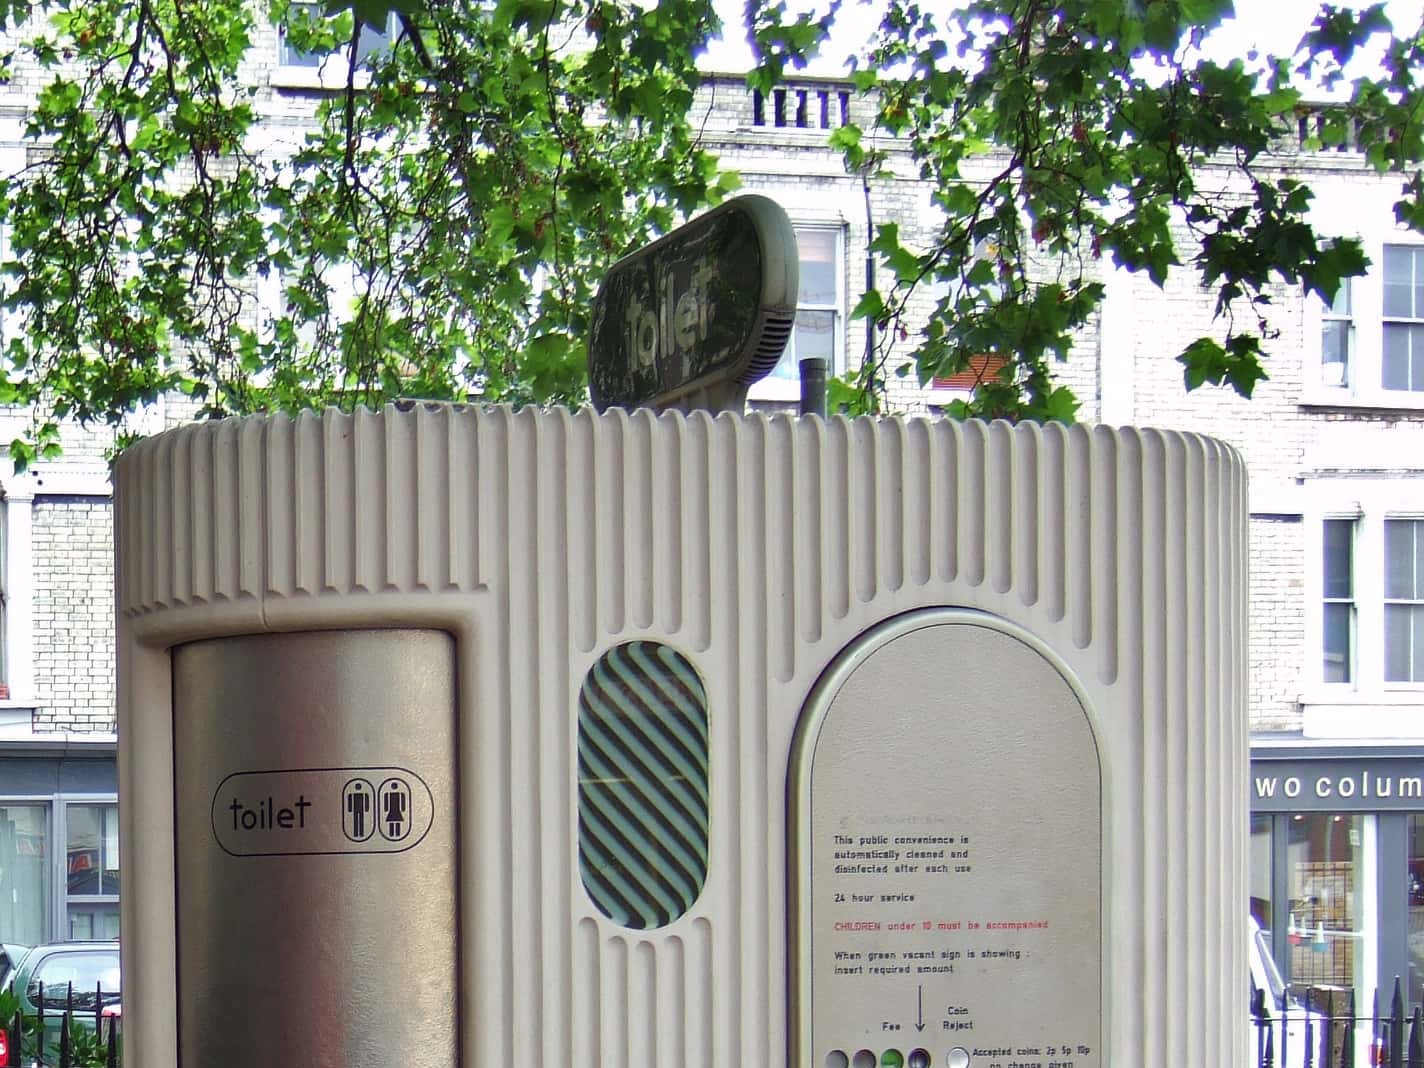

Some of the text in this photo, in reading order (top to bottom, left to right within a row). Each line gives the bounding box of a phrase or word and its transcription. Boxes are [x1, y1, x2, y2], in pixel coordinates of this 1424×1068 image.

[625, 258, 714, 373] toilet
[1255, 771, 1422, 798] wo colum
[229, 795, 312, 830] toilet
[834, 835, 968, 847] This public convenience is
[835, 849, 968, 861] automatically cleaned and
[835, 863, 972, 873] disinfected after each use
[834, 892, 914, 902] 24 hour service
[834, 920, 1048, 931] CHILDREN under 10 must be accompanied
[834, 952, 863, 960] When
[868, 952, 896, 962] green
[903, 951, 935, 959] vacant
[941, 950, 960, 960] sign
[968, 949, 975, 958] is
[981, 949, 1020, 960] showing
[835, 964, 954, 976] insert required amount
[948, 1006, 968, 1015] Coin
[882, 1022, 900, 1031] Fee
[943, 1020, 973, 1031] Reject
[973, 1048, 1012, 1058] Accepted
